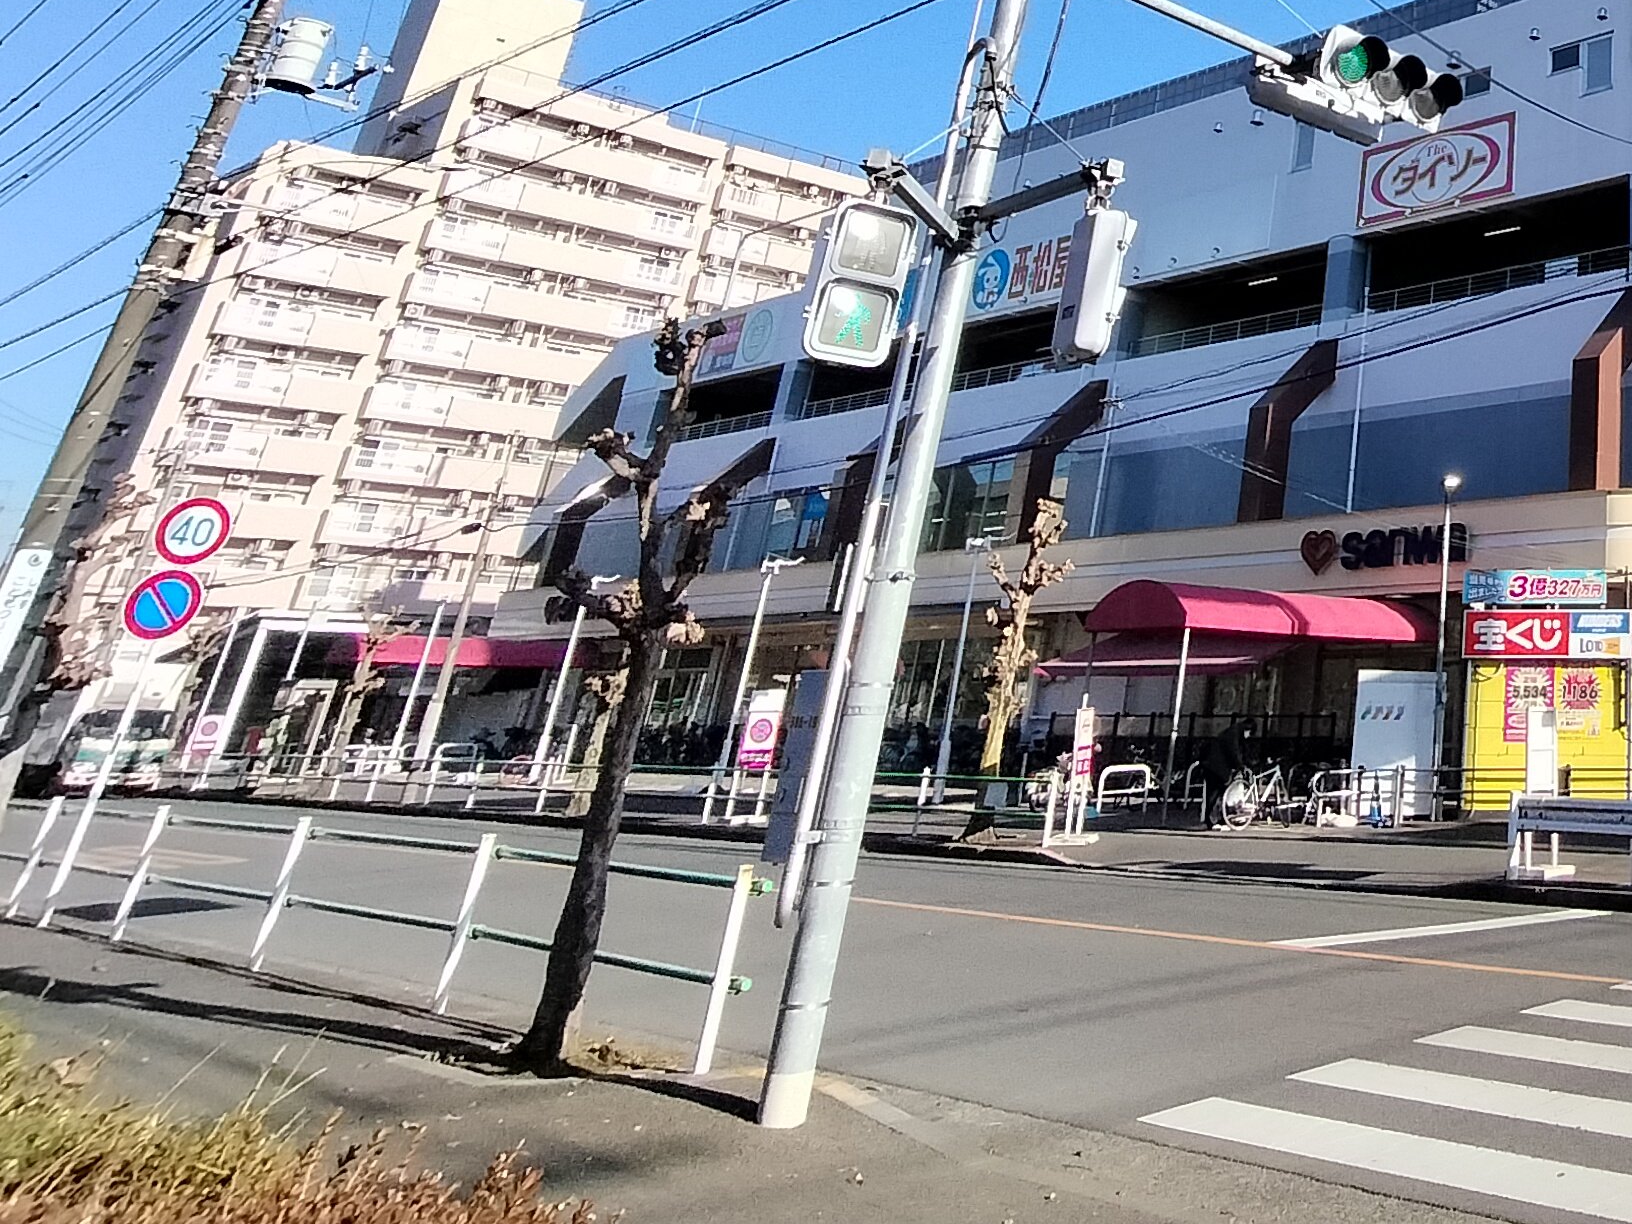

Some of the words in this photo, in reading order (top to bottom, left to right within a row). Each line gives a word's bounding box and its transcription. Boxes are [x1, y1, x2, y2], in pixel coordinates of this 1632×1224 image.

[1426, 143, 1448, 158] The
[1391, 146, 1488, 198] ダイソー
[1008, 235, 1072, 299] 西松屋
[170, 517, 215, 547] 40
[1340, 523, 1468, 570] sanwa
[1472, 618, 1563, 651] 宝くじ
